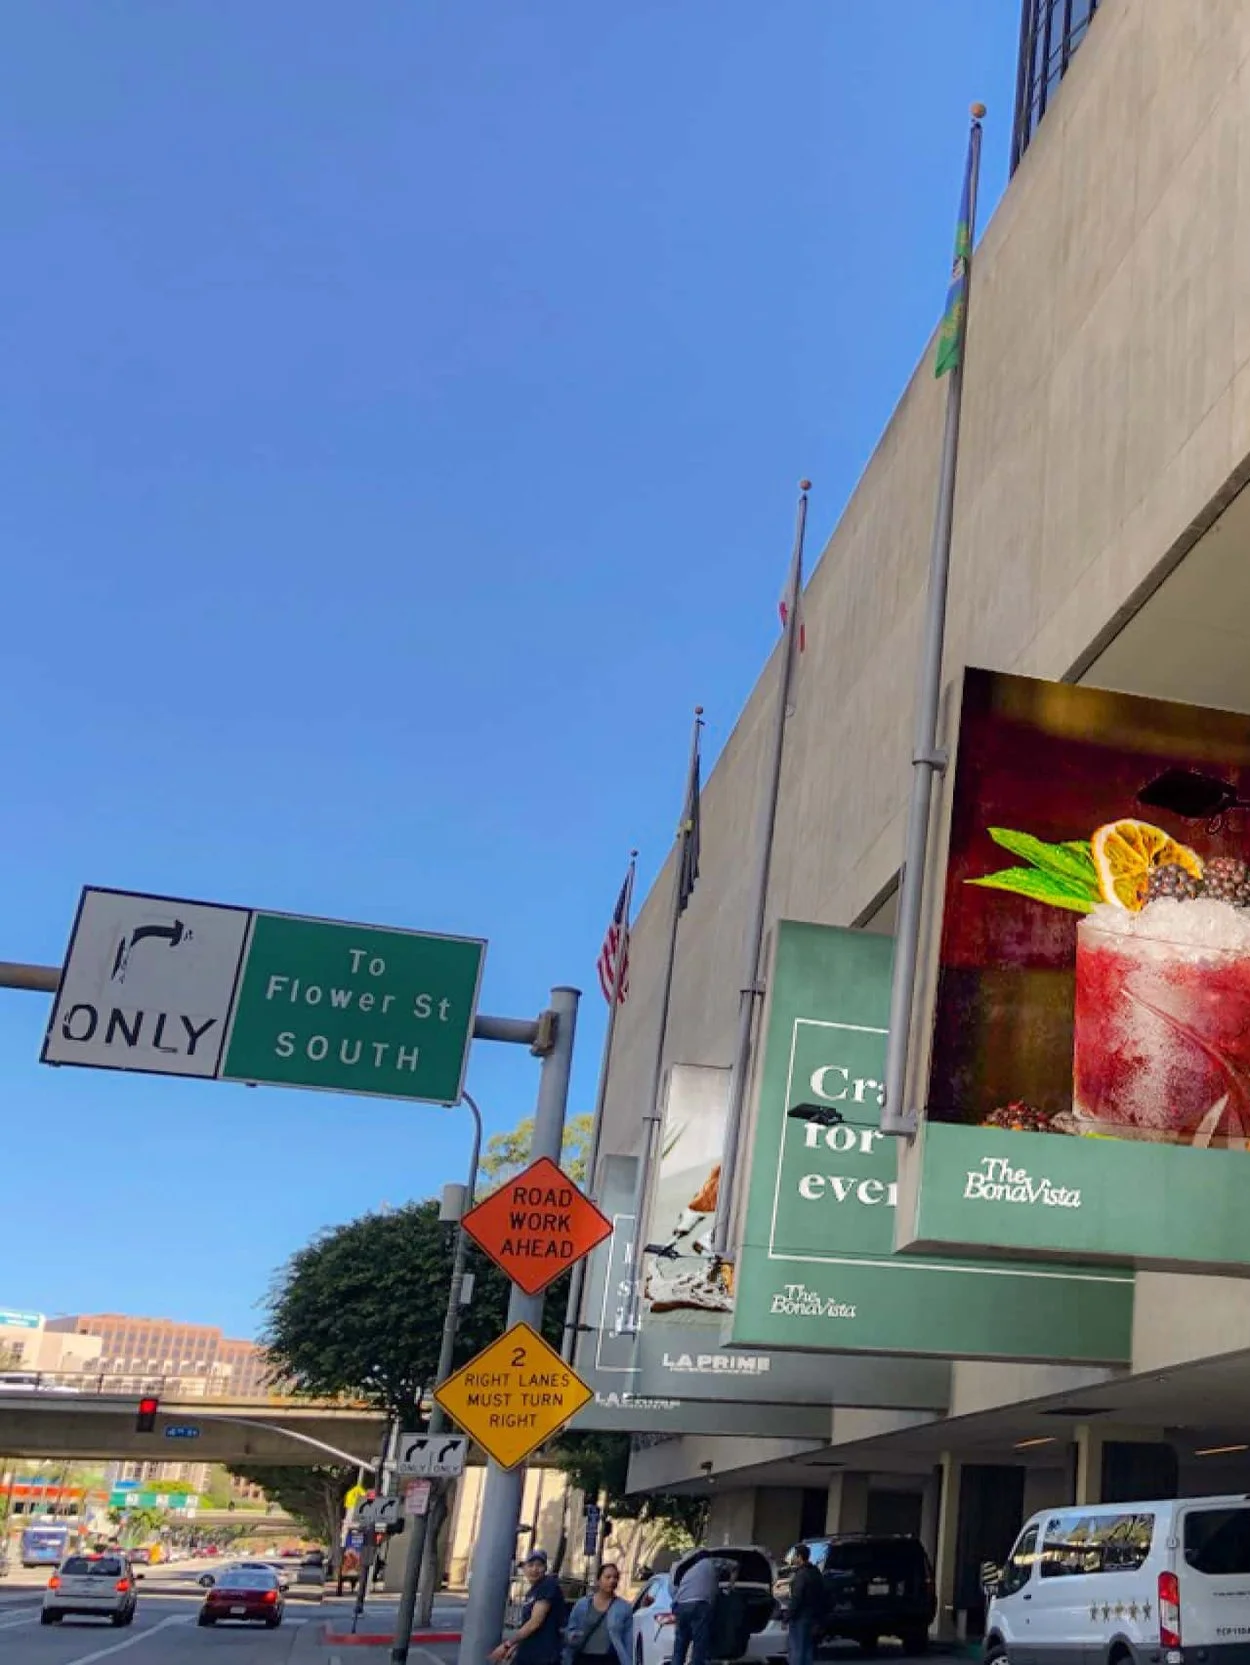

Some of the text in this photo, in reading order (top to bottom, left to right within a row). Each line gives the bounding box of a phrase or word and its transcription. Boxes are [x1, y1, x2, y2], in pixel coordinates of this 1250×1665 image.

[349, 948, 386, 977] To
[265, 974, 452, 1022] Flower St
[62, 1004, 218, 1056] ONLY
[275, 1031, 420, 1072] SOUTH
[981, 1156, 1027, 1185] The
[512, 1186, 573, 1208] ROAD
[509, 1211, 571, 1233] WORK
[500, 1238, 574, 1259] AHEAD
[784, 1284, 818, 1303] The
[511, 1346, 527, 1367] 2
[697, 1353, 771, 1372] PRIME
[464, 1372, 570, 1388] RIGHT LANES
[467, 1392, 564, 1408] MUST TURN
[489, 1412, 537, 1428] RIGHT
